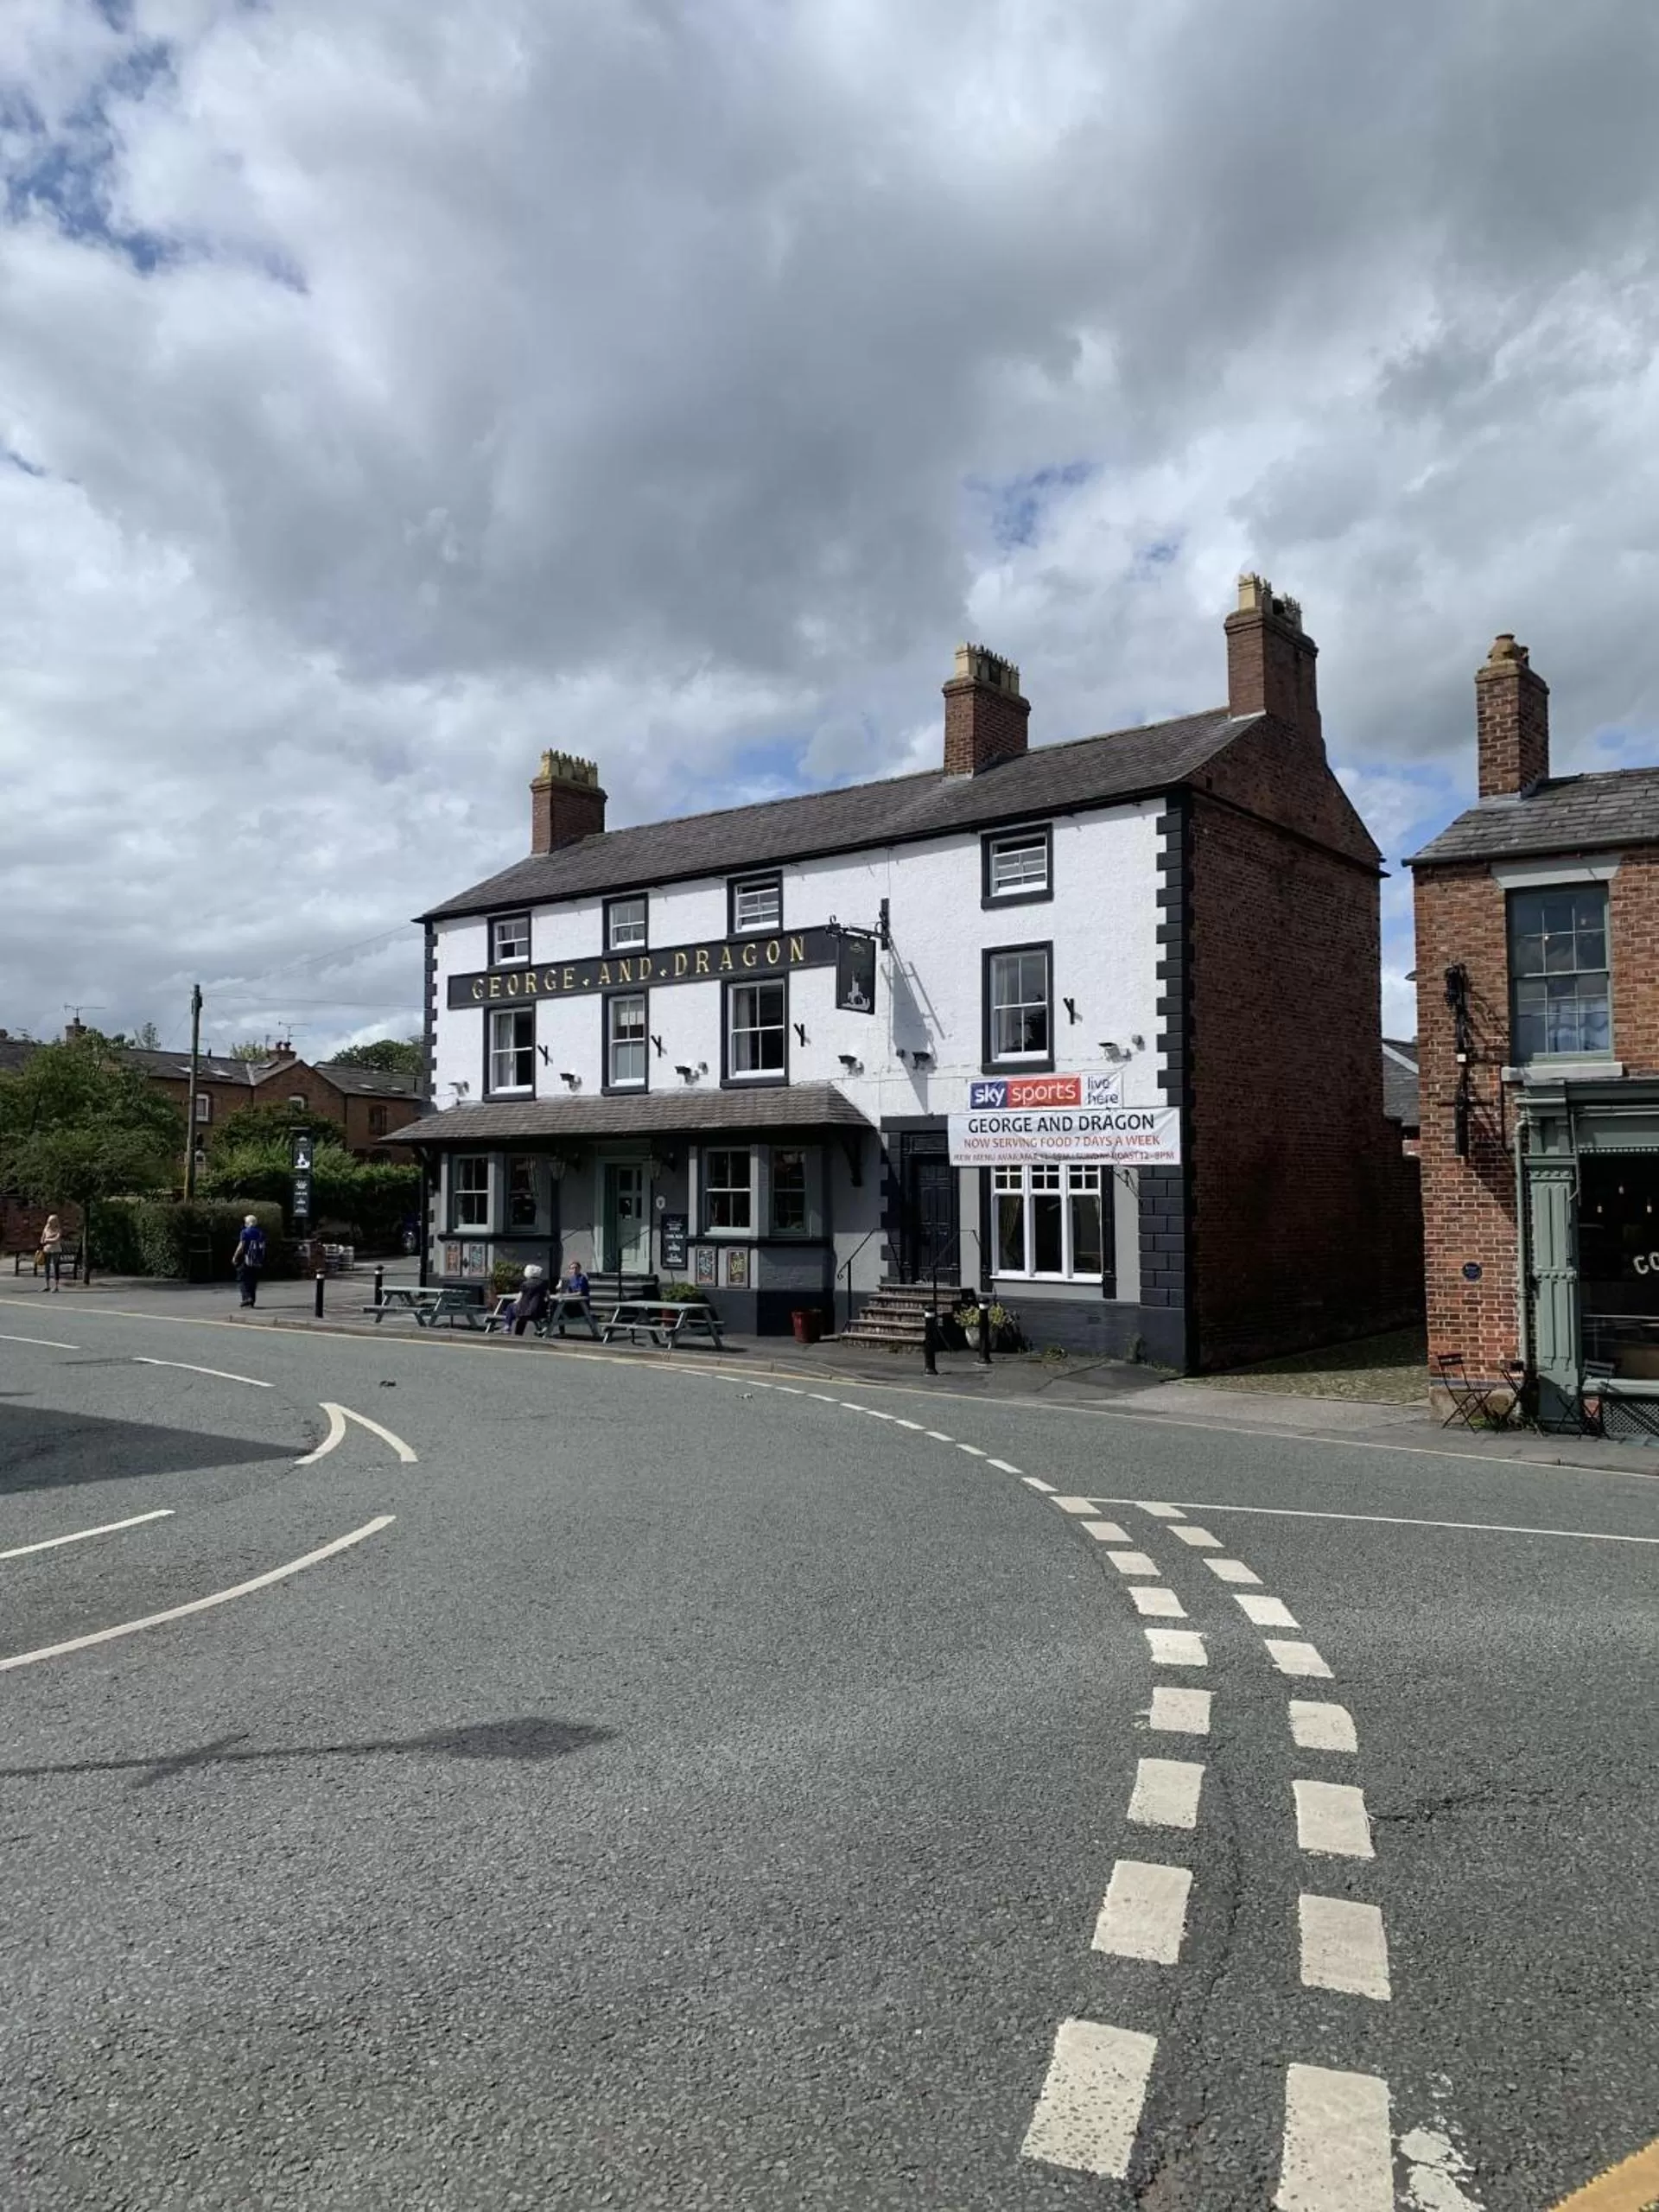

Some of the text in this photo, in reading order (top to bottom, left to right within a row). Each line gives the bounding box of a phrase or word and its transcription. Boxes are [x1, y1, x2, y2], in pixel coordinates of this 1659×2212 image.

[471, 935, 805, 1000] GEORGE AND DRAGON
[974, 1082, 1076, 1106] sky sports
[1087, 1092, 1118, 1105] here
[968, 1114, 1154, 1134] GEORGE AND DRAGON
[964, 1135, 1160, 1148] NOW SERVING FOOD 7 DAYS A WEEK
